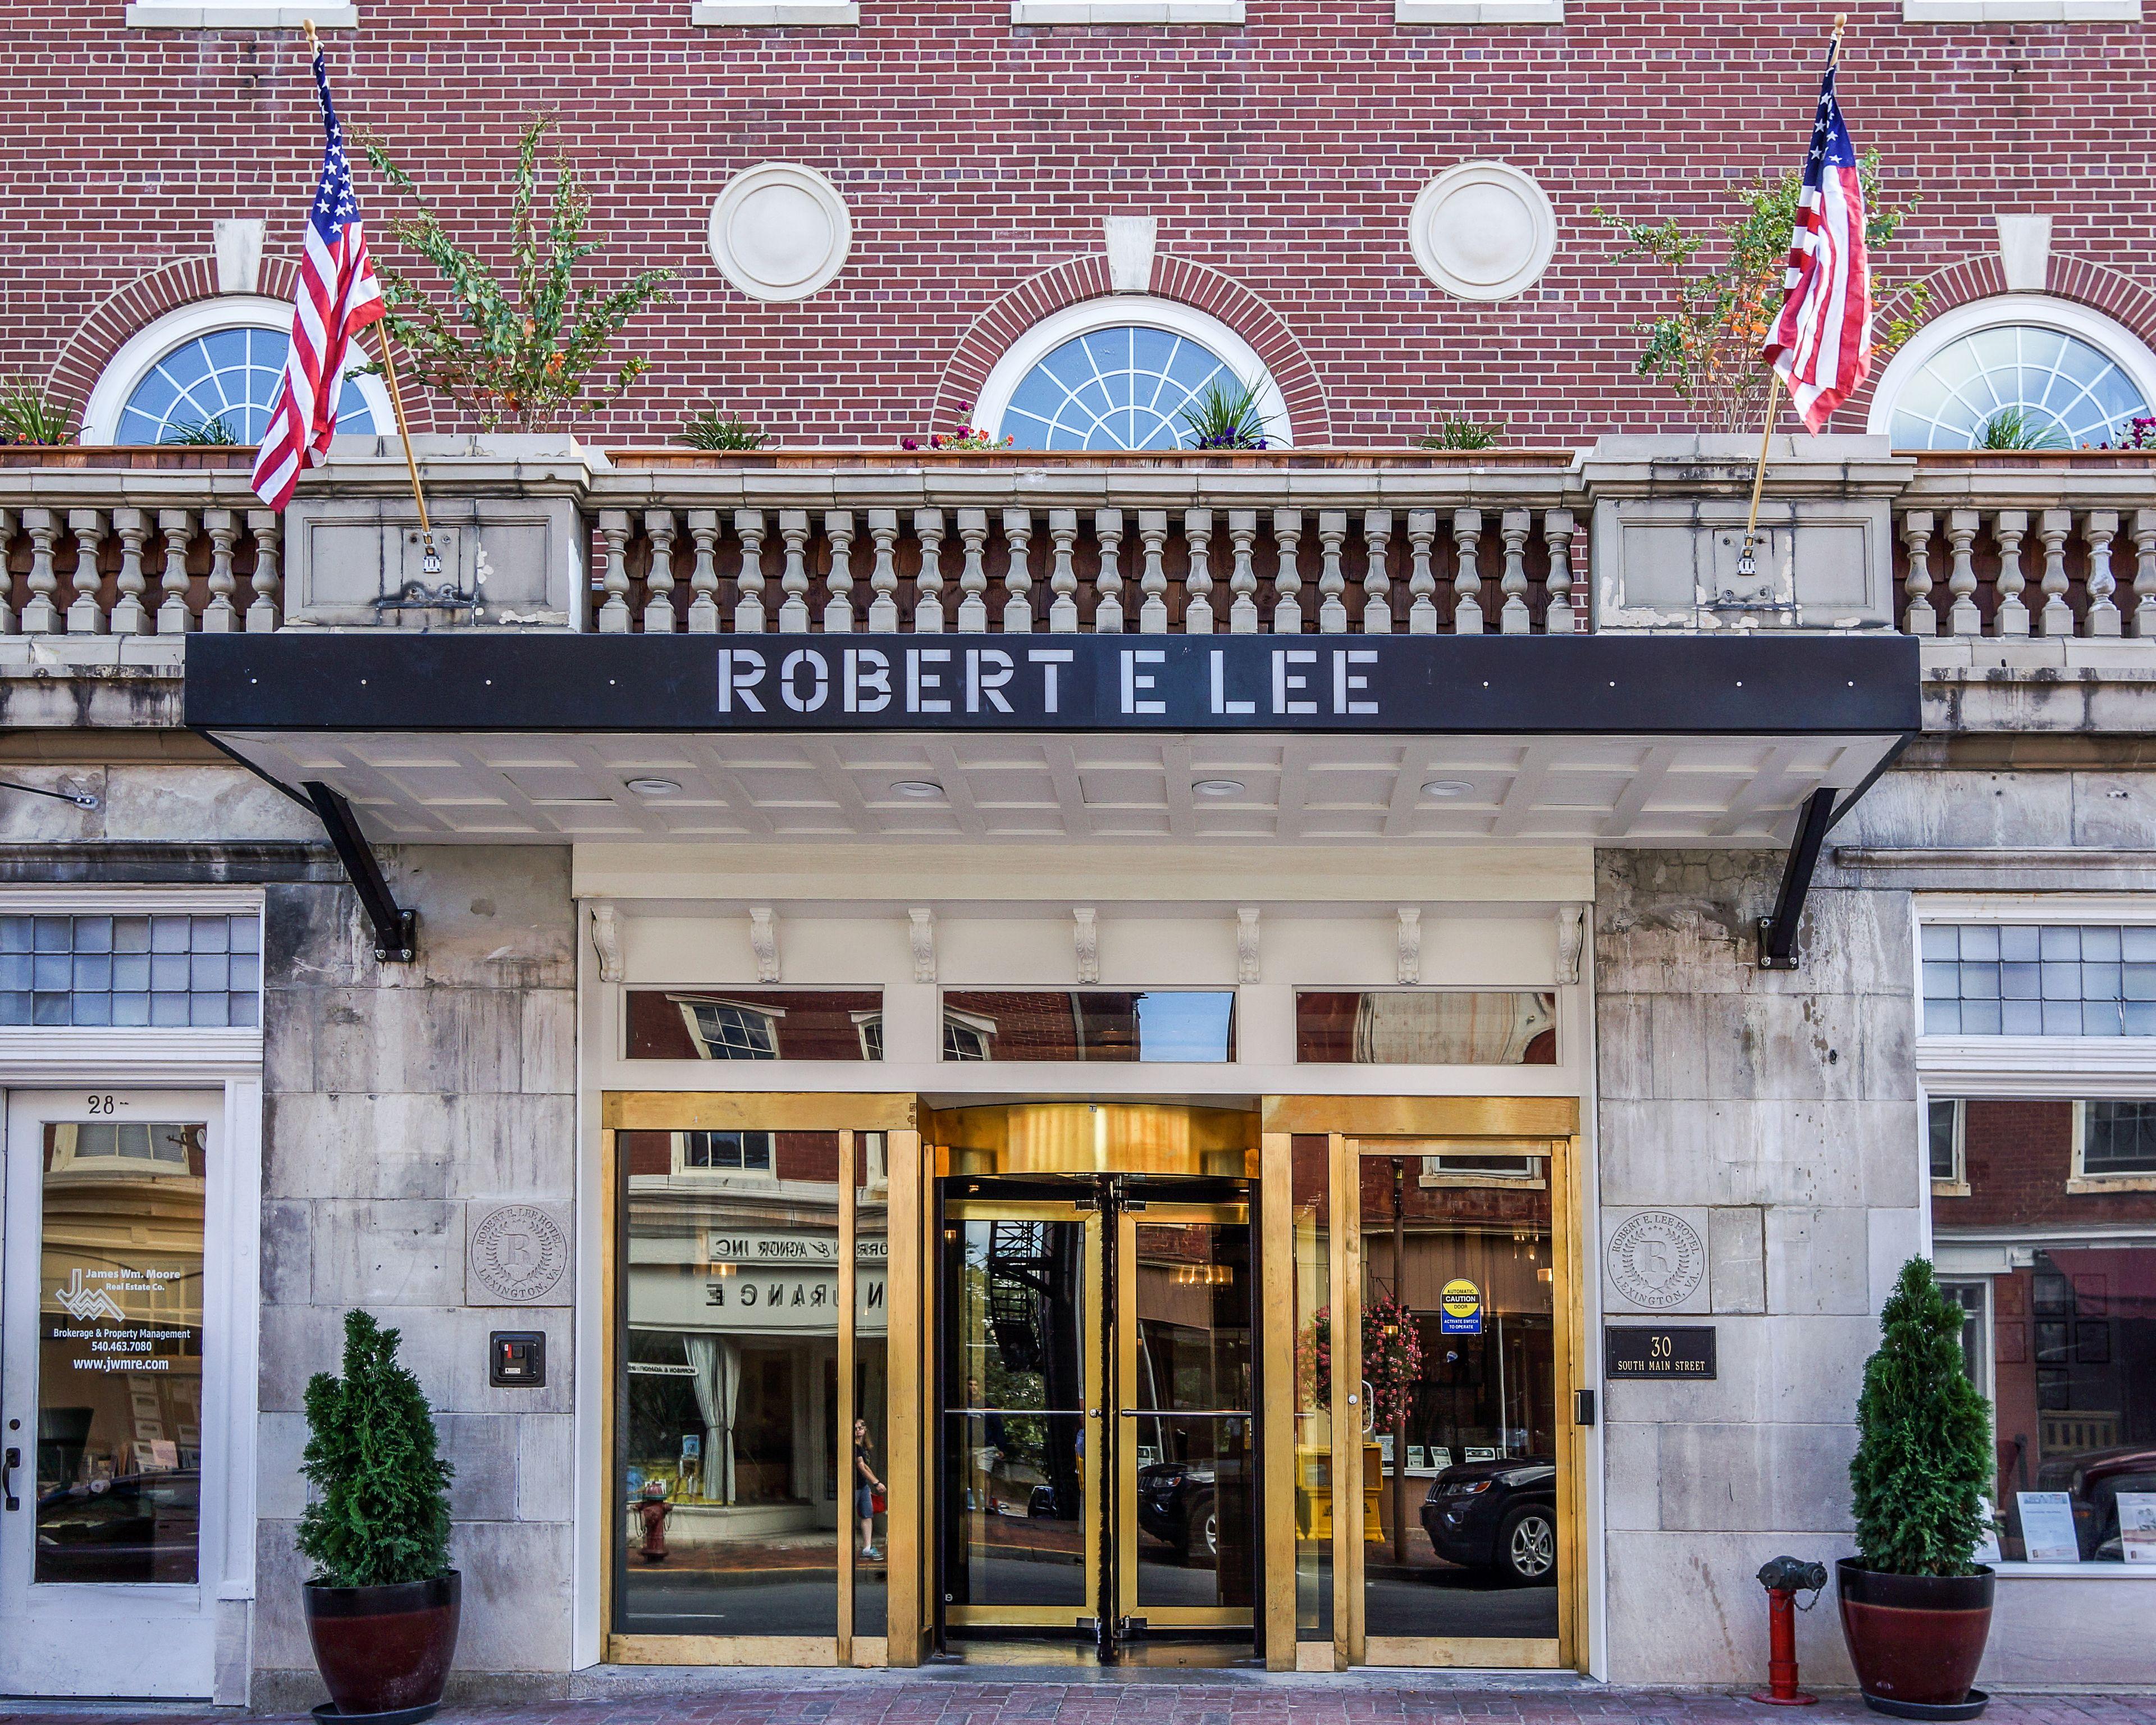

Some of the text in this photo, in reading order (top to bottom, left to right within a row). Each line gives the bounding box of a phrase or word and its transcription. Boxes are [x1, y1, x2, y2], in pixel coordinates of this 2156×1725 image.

[718, 649, 1379, 714] ROBERT E LEE
[477, 1208, 562, 1248] ROBERT E. LEE HOTEL
[1612, 1215, 1700, 1255] ROBERT E. LEE HOTEL
[85, 1268, 181, 1279] James Wm. Moore
[106, 1283, 123, 1291] Real
[125, 1283, 150, 1291] Estate
[479, 1268, 548, 1298] LEXINGTON,
[1615, 1272, 1700, 1306] LEXINGTON, VA.
[53, 1327, 191, 1340] Brokerage & Property Management
[92, 1341, 152, 1352] 540.463.7080
[1651, 1336, 1672, 1358] 30
[73, 1357, 169, 1372] www.jwmre.com
[1618, 1361, 1706, 1371] SOUTH MAIN STREET
